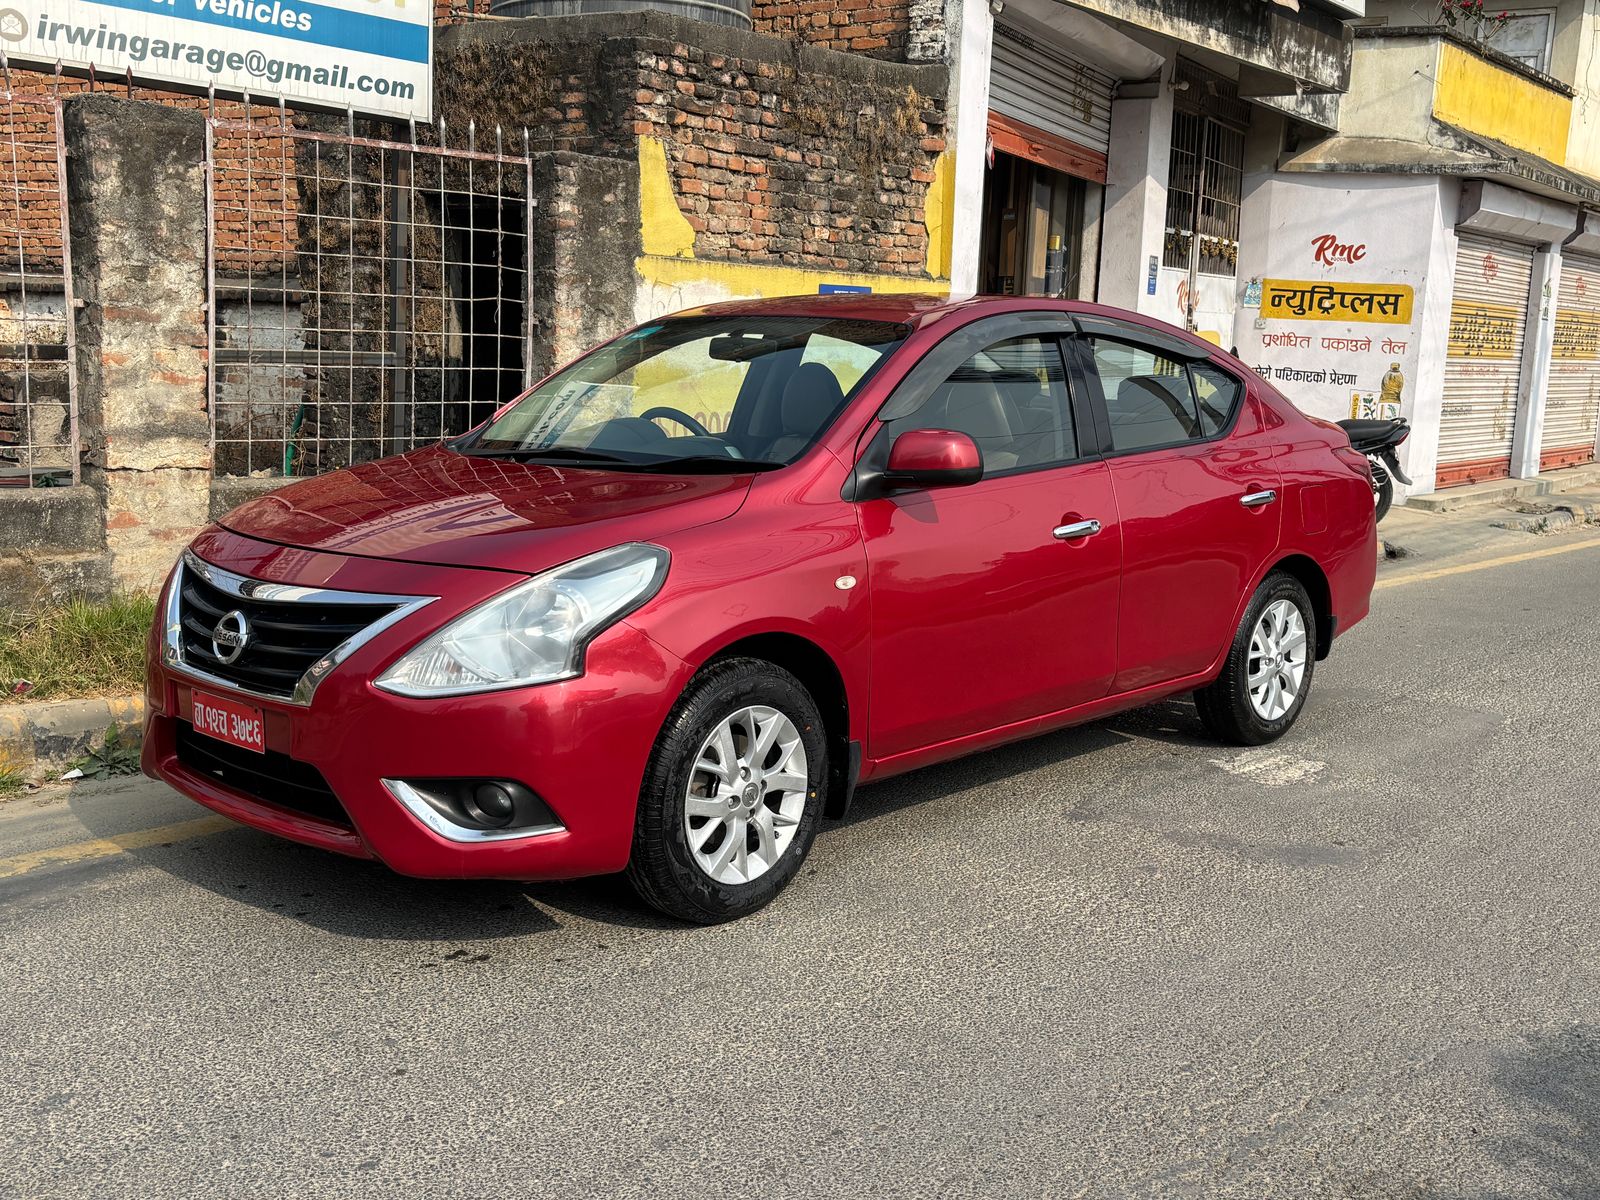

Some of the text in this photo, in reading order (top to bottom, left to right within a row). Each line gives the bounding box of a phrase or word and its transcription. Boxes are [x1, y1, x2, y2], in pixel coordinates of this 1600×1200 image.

[36, 14, 415, 100] irwingarage@gmail.com
[1270, 285, 1405, 316] न्युट्रिप्लस
[1262, 331, 1408, 355] प्रशोधित पकाउने तेल
[1274, 367, 1327, 384] परिकारको
[1329, 369, 1358, 386] प्रेरणा
